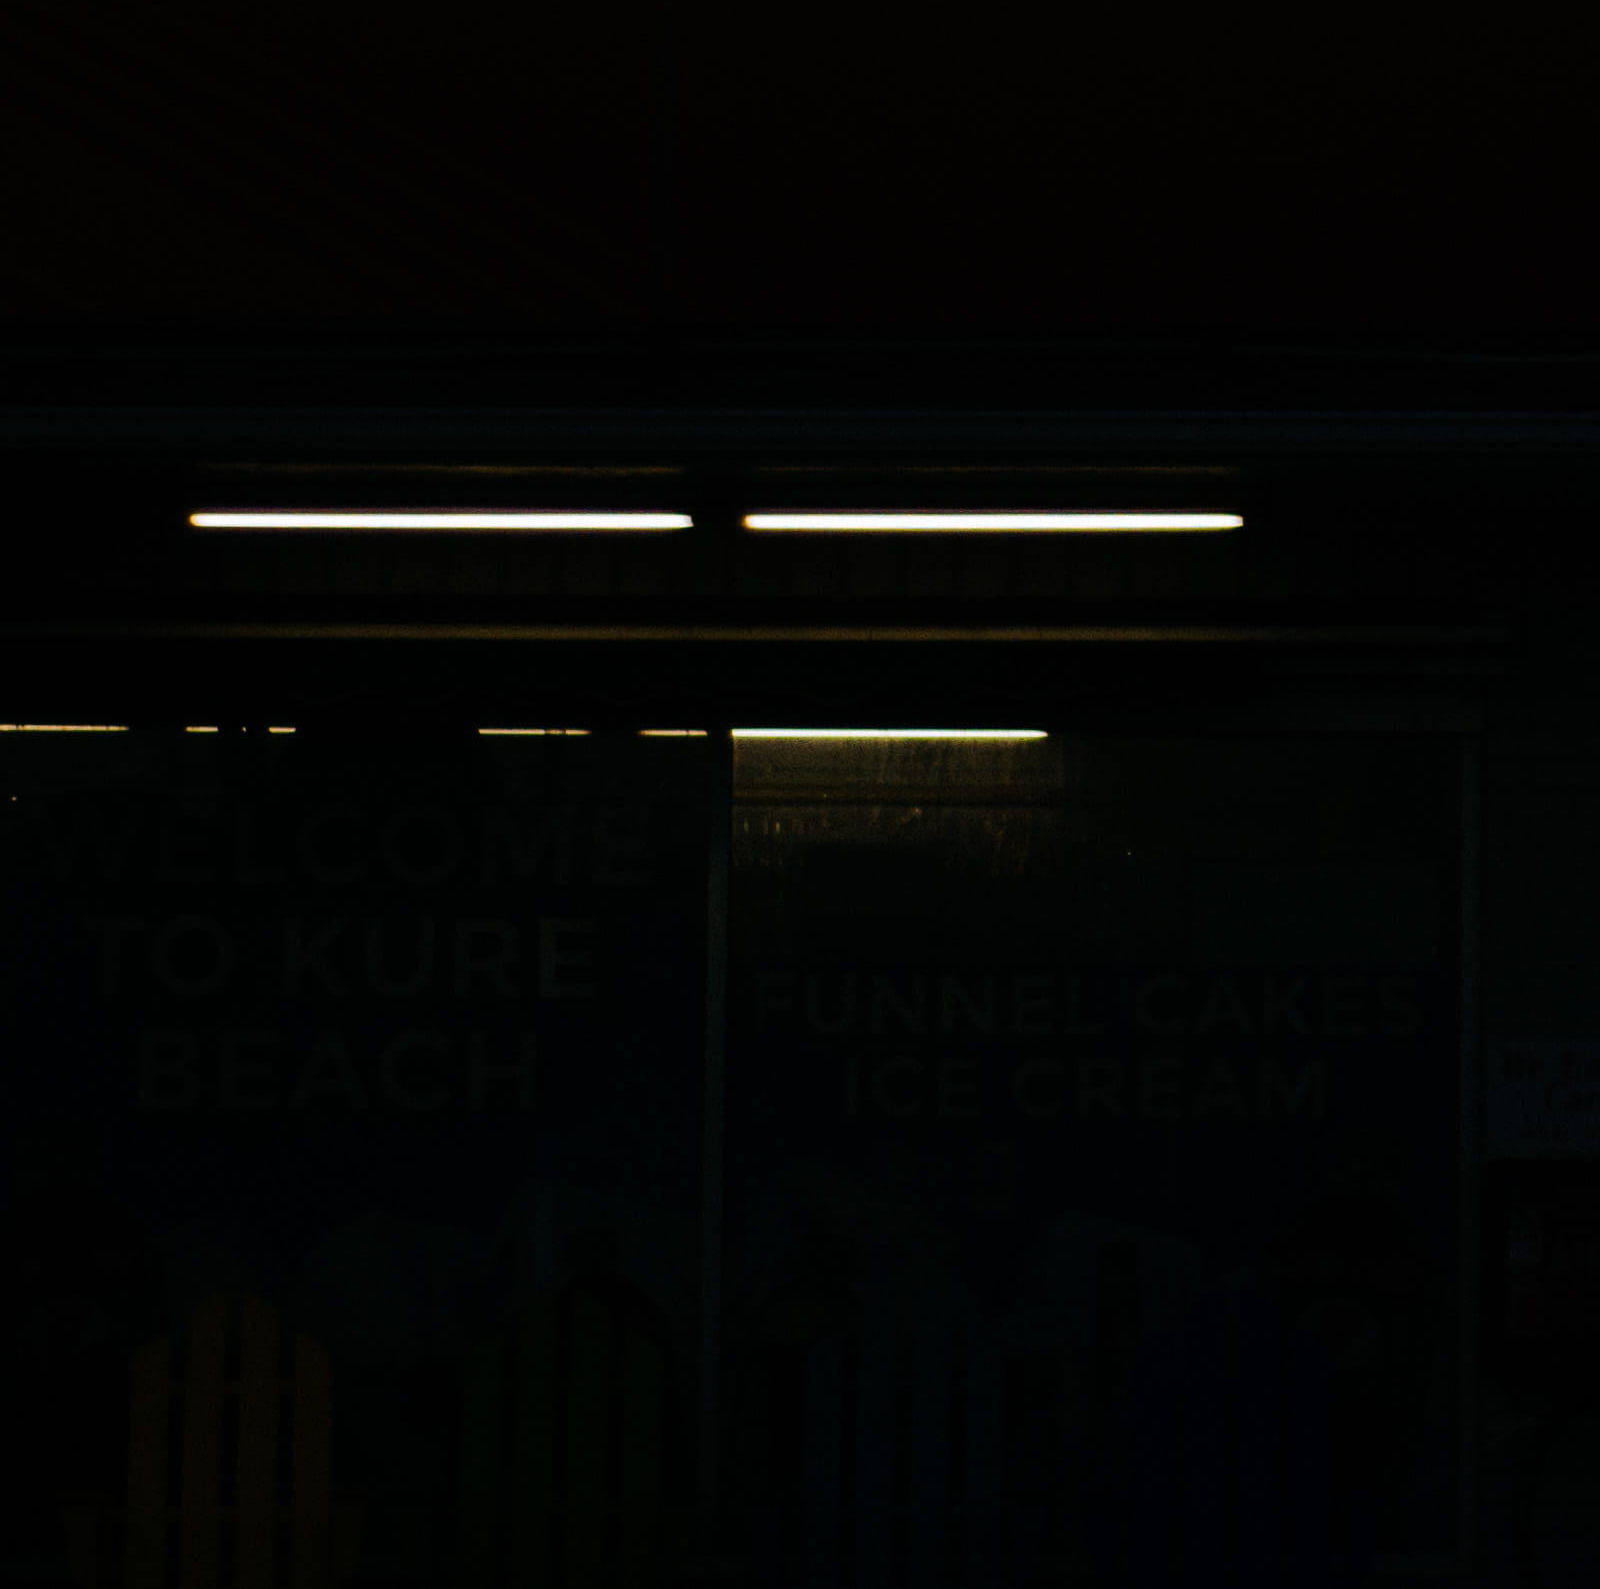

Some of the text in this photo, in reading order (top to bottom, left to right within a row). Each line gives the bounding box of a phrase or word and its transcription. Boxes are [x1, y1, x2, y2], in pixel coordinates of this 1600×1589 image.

[30, 803, 652, 886] WELCOME
[82, 915, 600, 1000] TO KURE
[753, 971, 1426, 1040] FUNNEL CAKES
[137, 1027, 539, 1112] BEACH
[844, 1057, 1329, 1121] ICE CREAM
